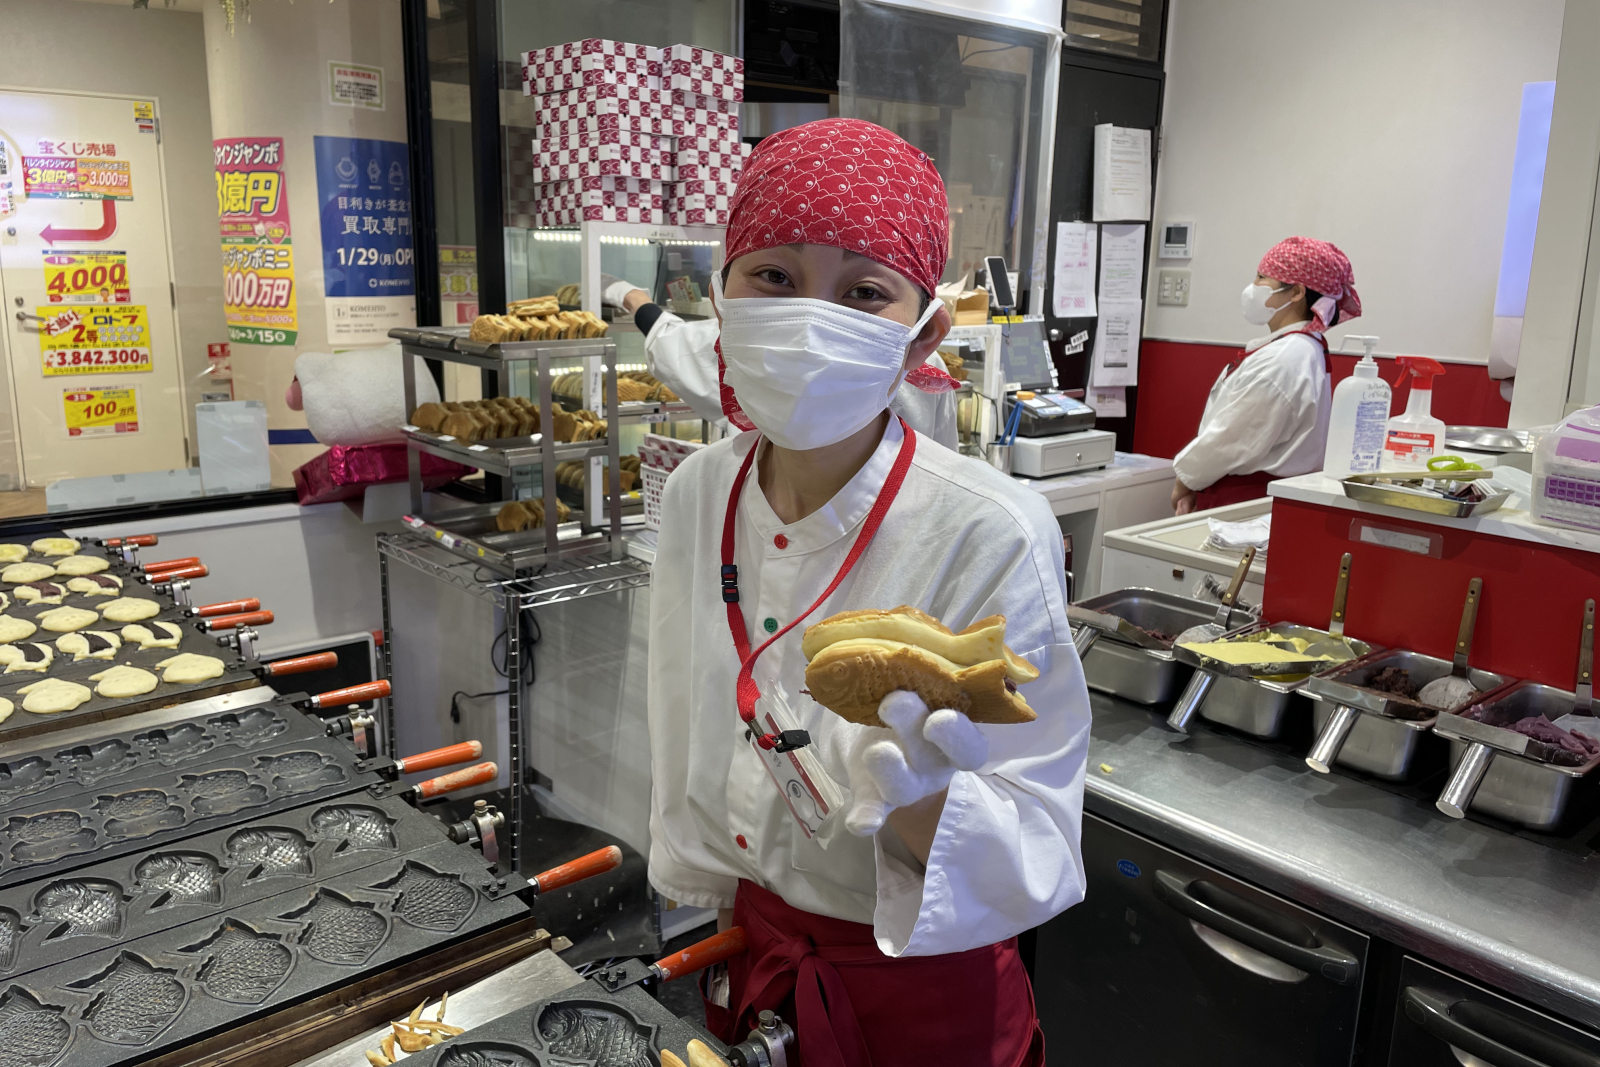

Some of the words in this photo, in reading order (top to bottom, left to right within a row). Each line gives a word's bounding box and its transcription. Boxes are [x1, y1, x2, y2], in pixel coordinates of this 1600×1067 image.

[38, 141, 116, 157] 宝くじ売場
[26, 168, 67, 185] 3億円
[341, 215, 413, 235] 買取専門
[93, 315, 139, 325] ロト7
[72, 324, 98, 343] 2等
